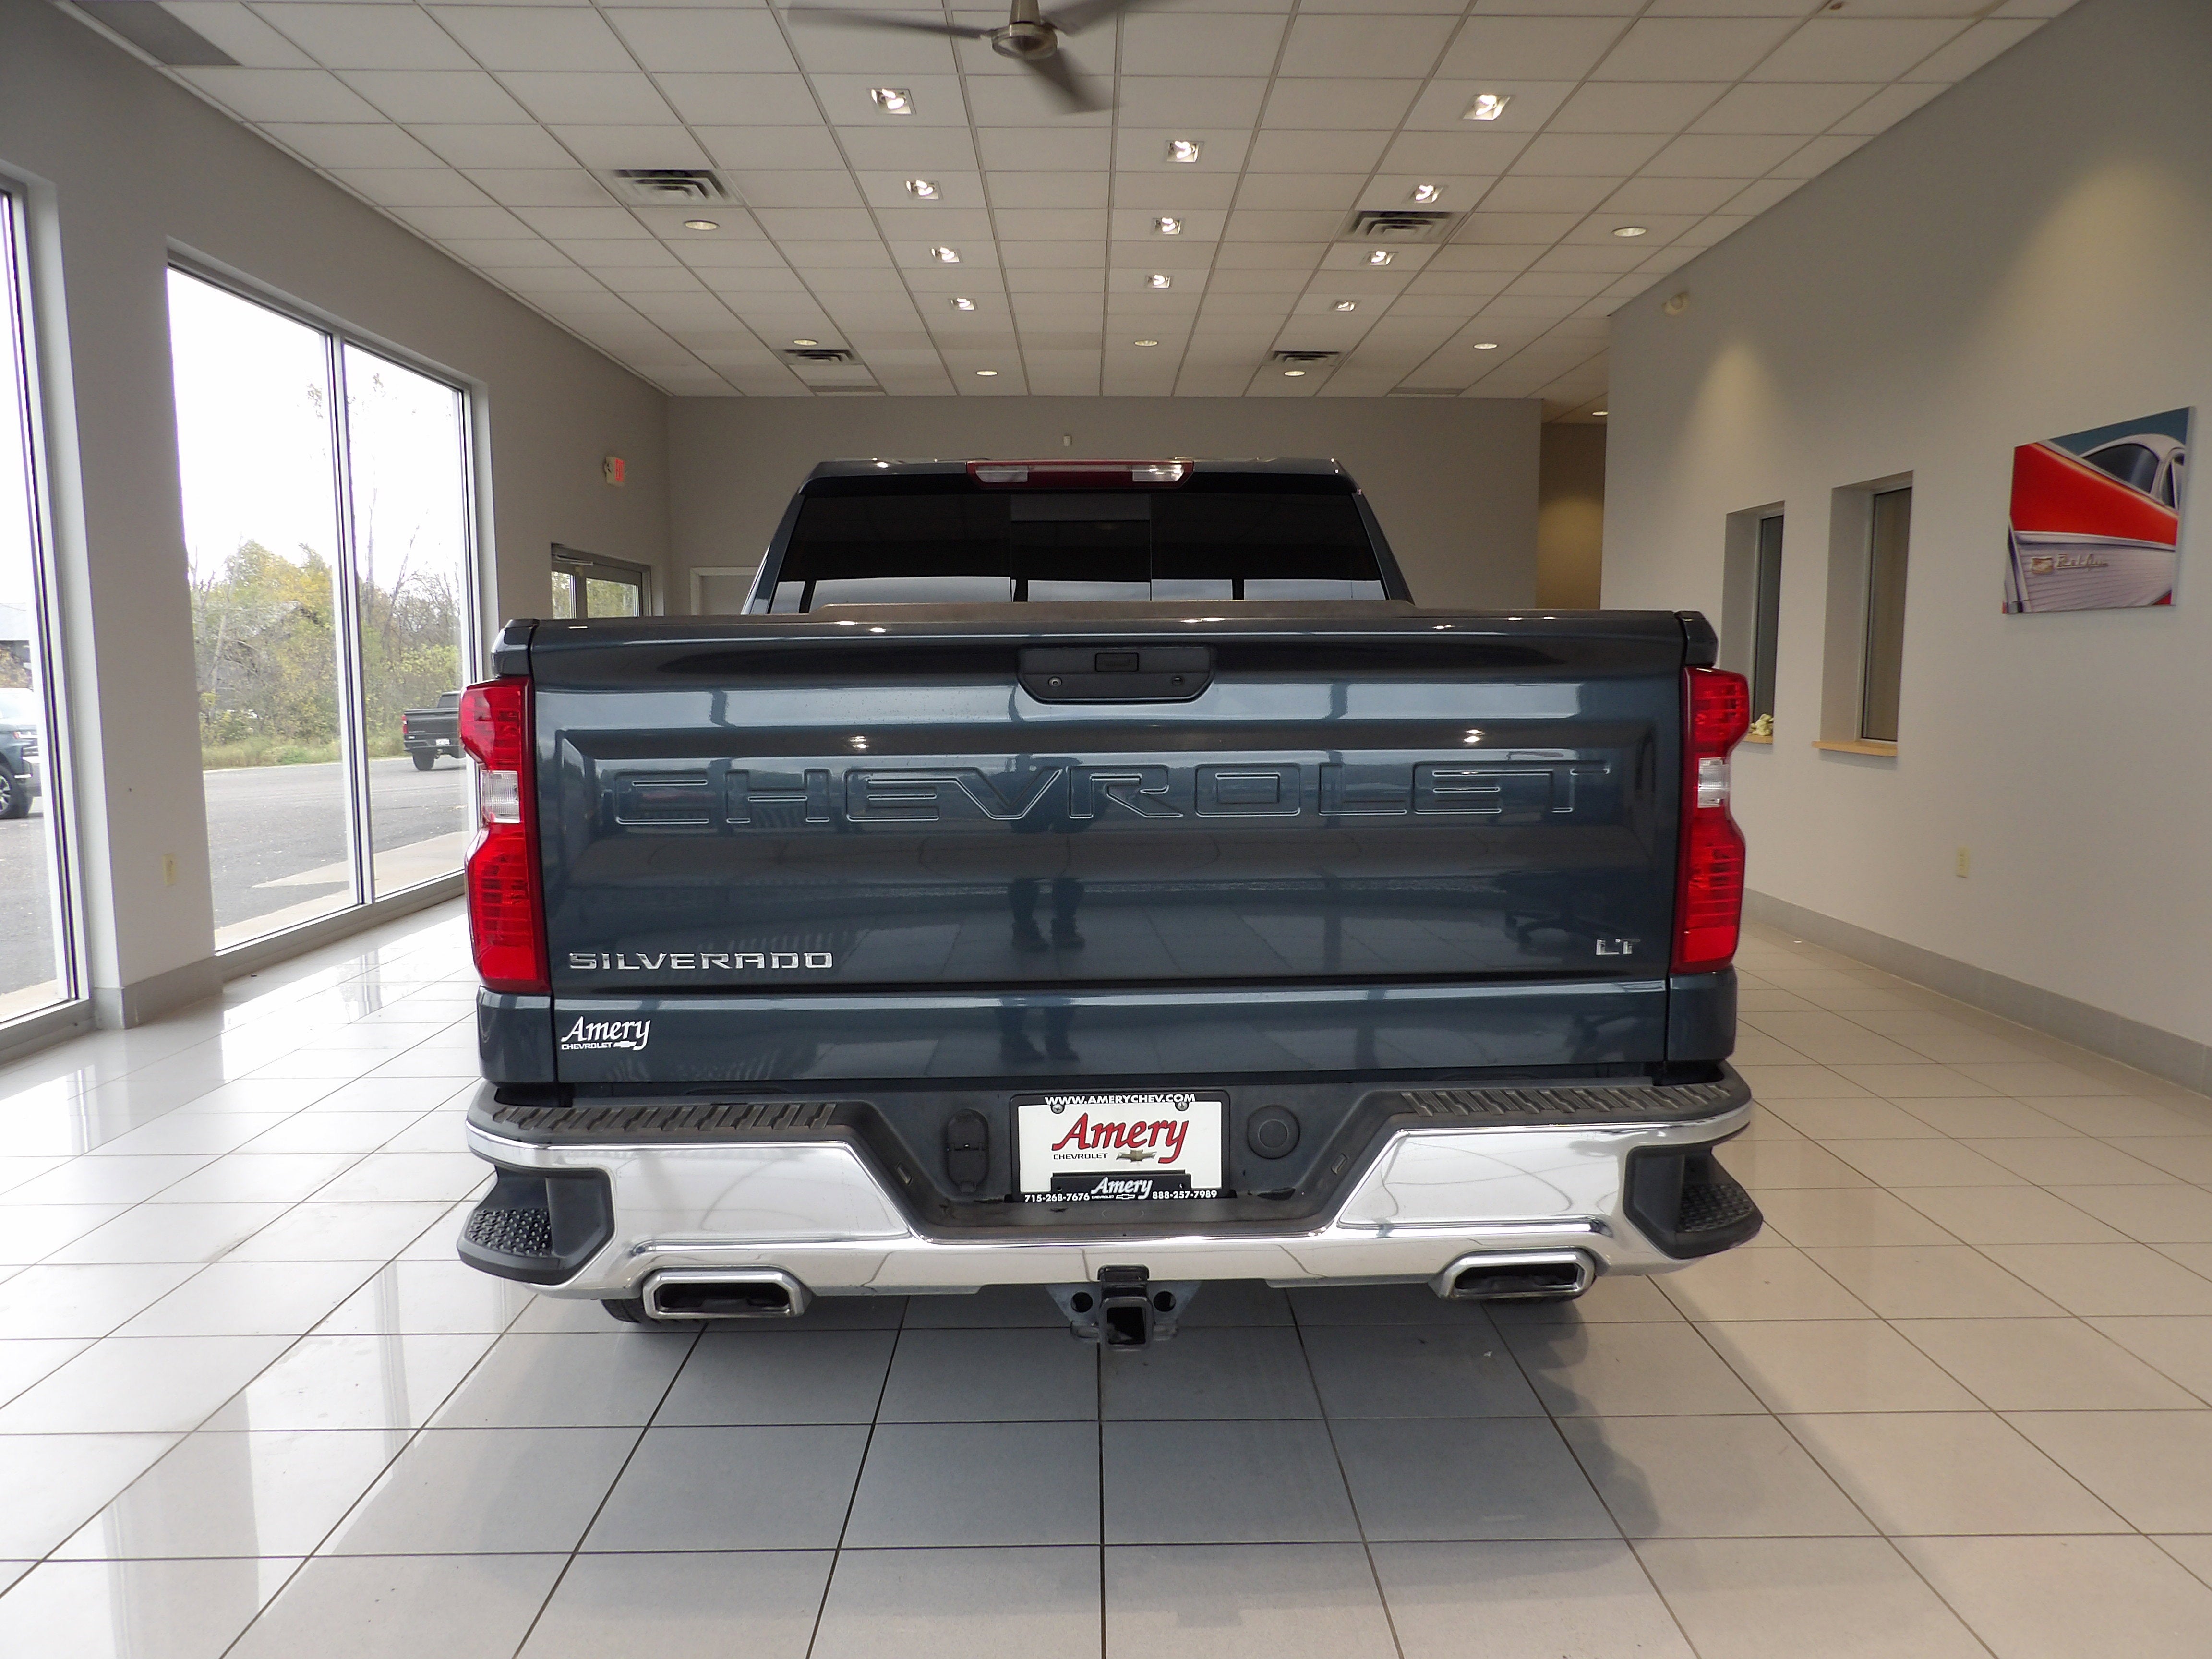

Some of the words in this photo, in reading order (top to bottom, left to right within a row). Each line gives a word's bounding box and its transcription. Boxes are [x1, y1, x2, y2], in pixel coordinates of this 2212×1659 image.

[614, 760, 1609, 824] CHEVROLET
[1596, 938, 1641, 955] LT
[569, 952, 834, 970] SILVERADO
[561, 1016, 651, 1051] Amery
[561, 1041, 613, 1050] CHEVROLET
[1045, 1094, 1196, 1105] WWW.AMERYCHEV.COM
[1051, 1112, 1190, 1164] Amery
[1090, 1176, 1153, 1199] Amery
[1152, 1190, 1217, 1199] 888-257-7989
[1024, 1193, 1090, 1202] 715-268-7676
